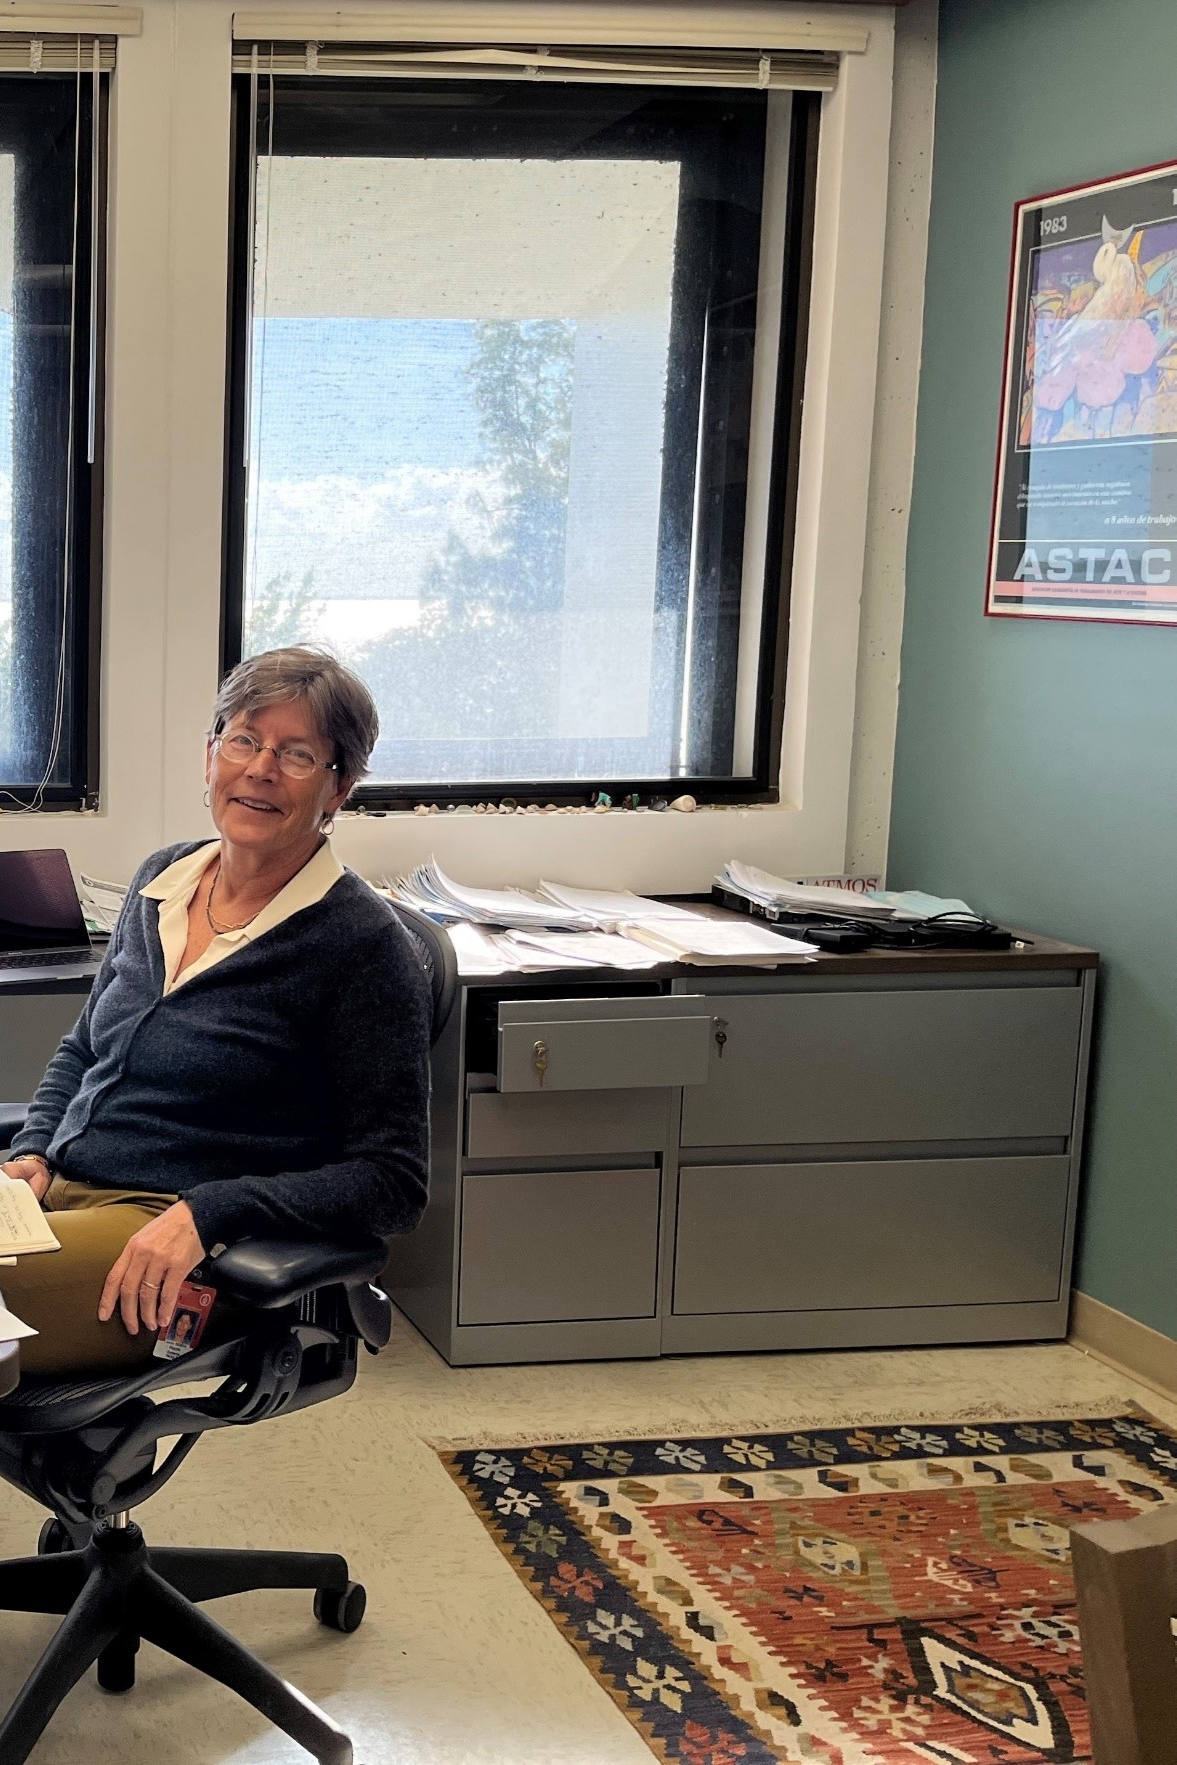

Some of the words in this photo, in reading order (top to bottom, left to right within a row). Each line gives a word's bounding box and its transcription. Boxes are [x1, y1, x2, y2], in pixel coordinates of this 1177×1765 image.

[1039, 215, 1068, 236] 1983
[1137, 514, 1147, 524] de
[1147, 514, 1177, 527] trabajo
[1012, 547, 1172, 584] ASTAC
